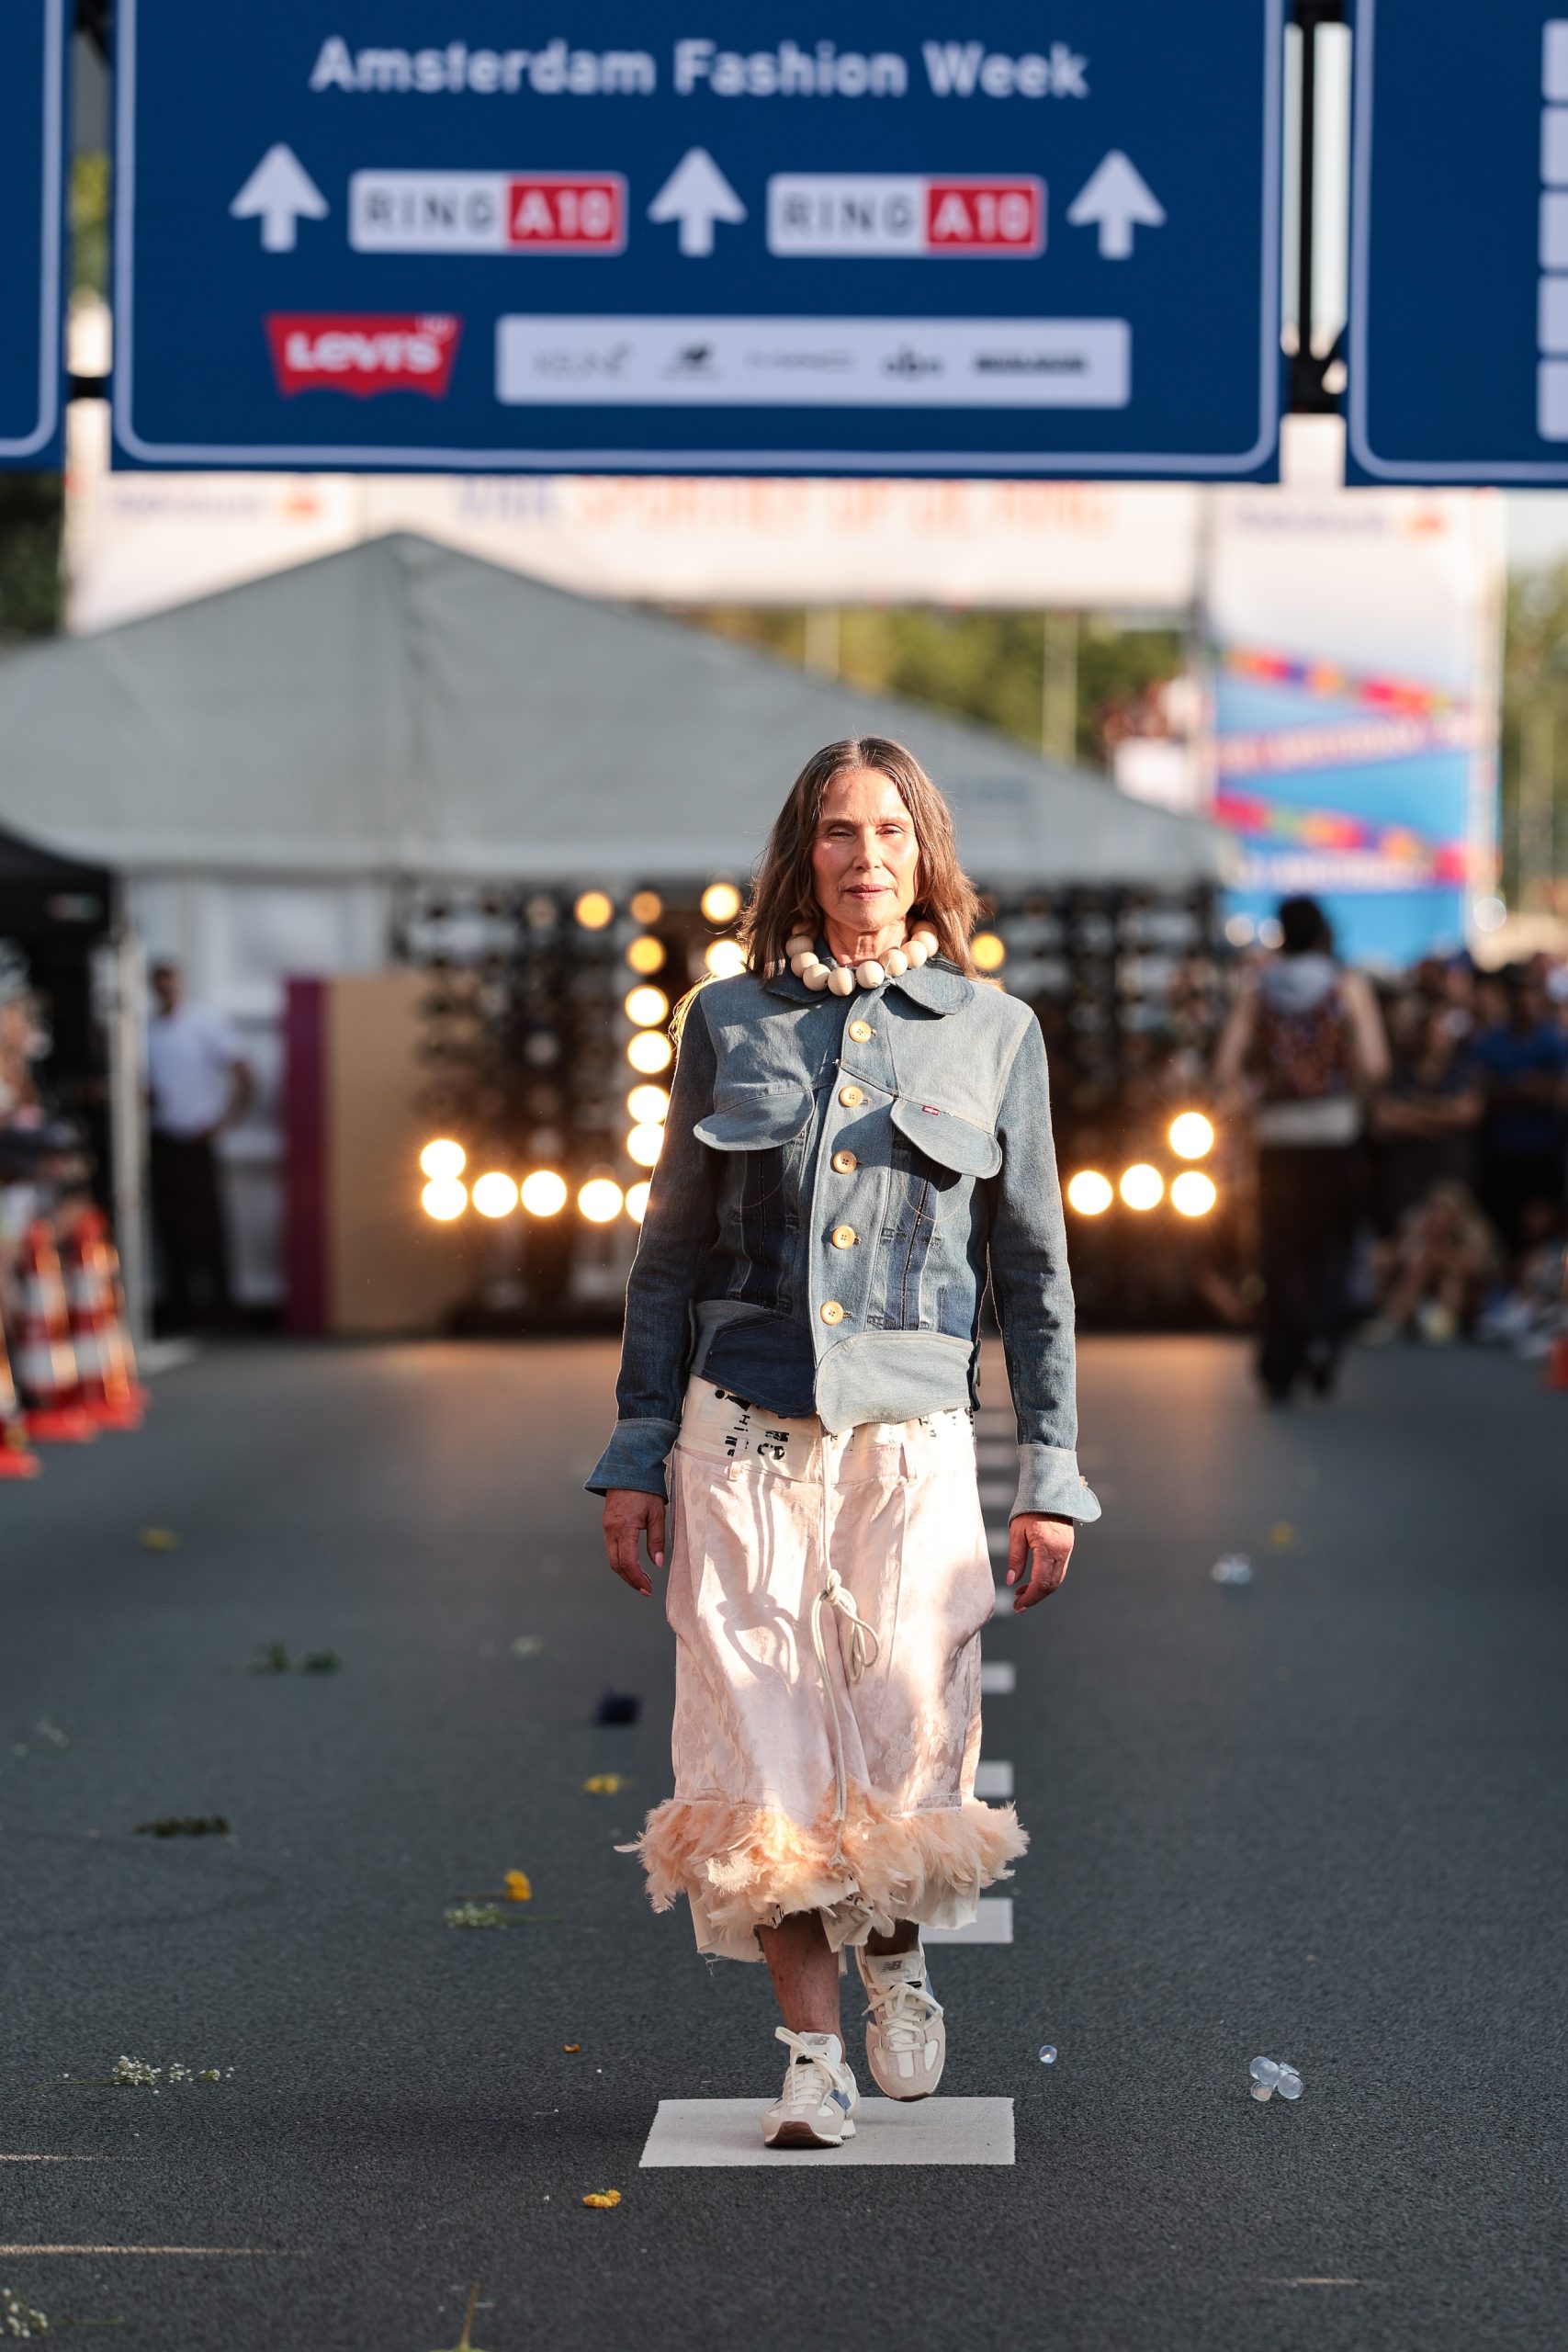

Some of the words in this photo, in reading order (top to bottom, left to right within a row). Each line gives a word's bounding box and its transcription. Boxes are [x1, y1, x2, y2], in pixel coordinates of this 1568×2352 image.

[310, 37, 656, 94] Amsterdam
[675, 40, 906, 95] Fashion
[924, 44, 1086, 96] Week
[366, 187, 497, 234] RING
[513, 187, 613, 238] A10
[780, 191, 917, 239] RING
[931, 191, 1030, 242] A10
